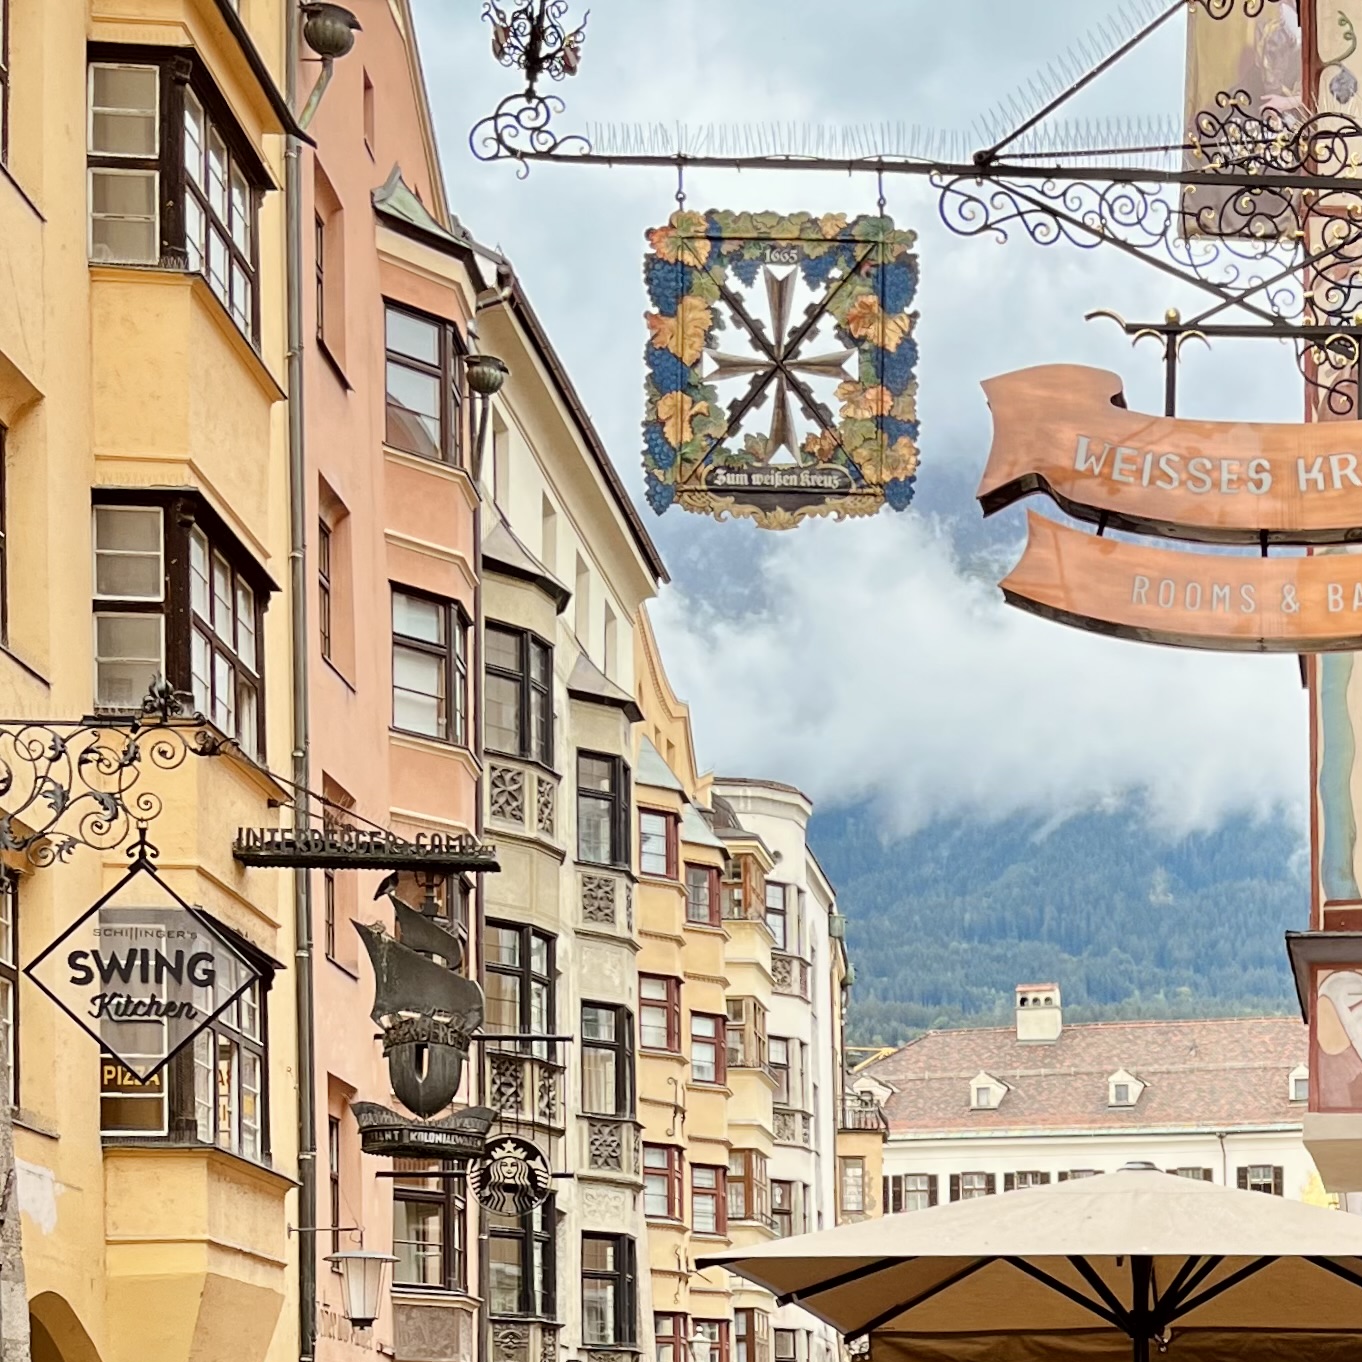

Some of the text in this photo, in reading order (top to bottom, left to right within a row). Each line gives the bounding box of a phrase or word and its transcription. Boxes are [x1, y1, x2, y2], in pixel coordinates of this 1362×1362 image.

[764, 246, 798, 264] 1665
[1074, 434, 1273, 495] WEISSES
[1131, 575, 1257, 614] ROOMS
[1280, 583, 1300, 614] &
[67, 948, 216, 988] SWING
[88, 991, 198, 1026] Kitchen
[103, 1064, 161, 1087] PIZZA
